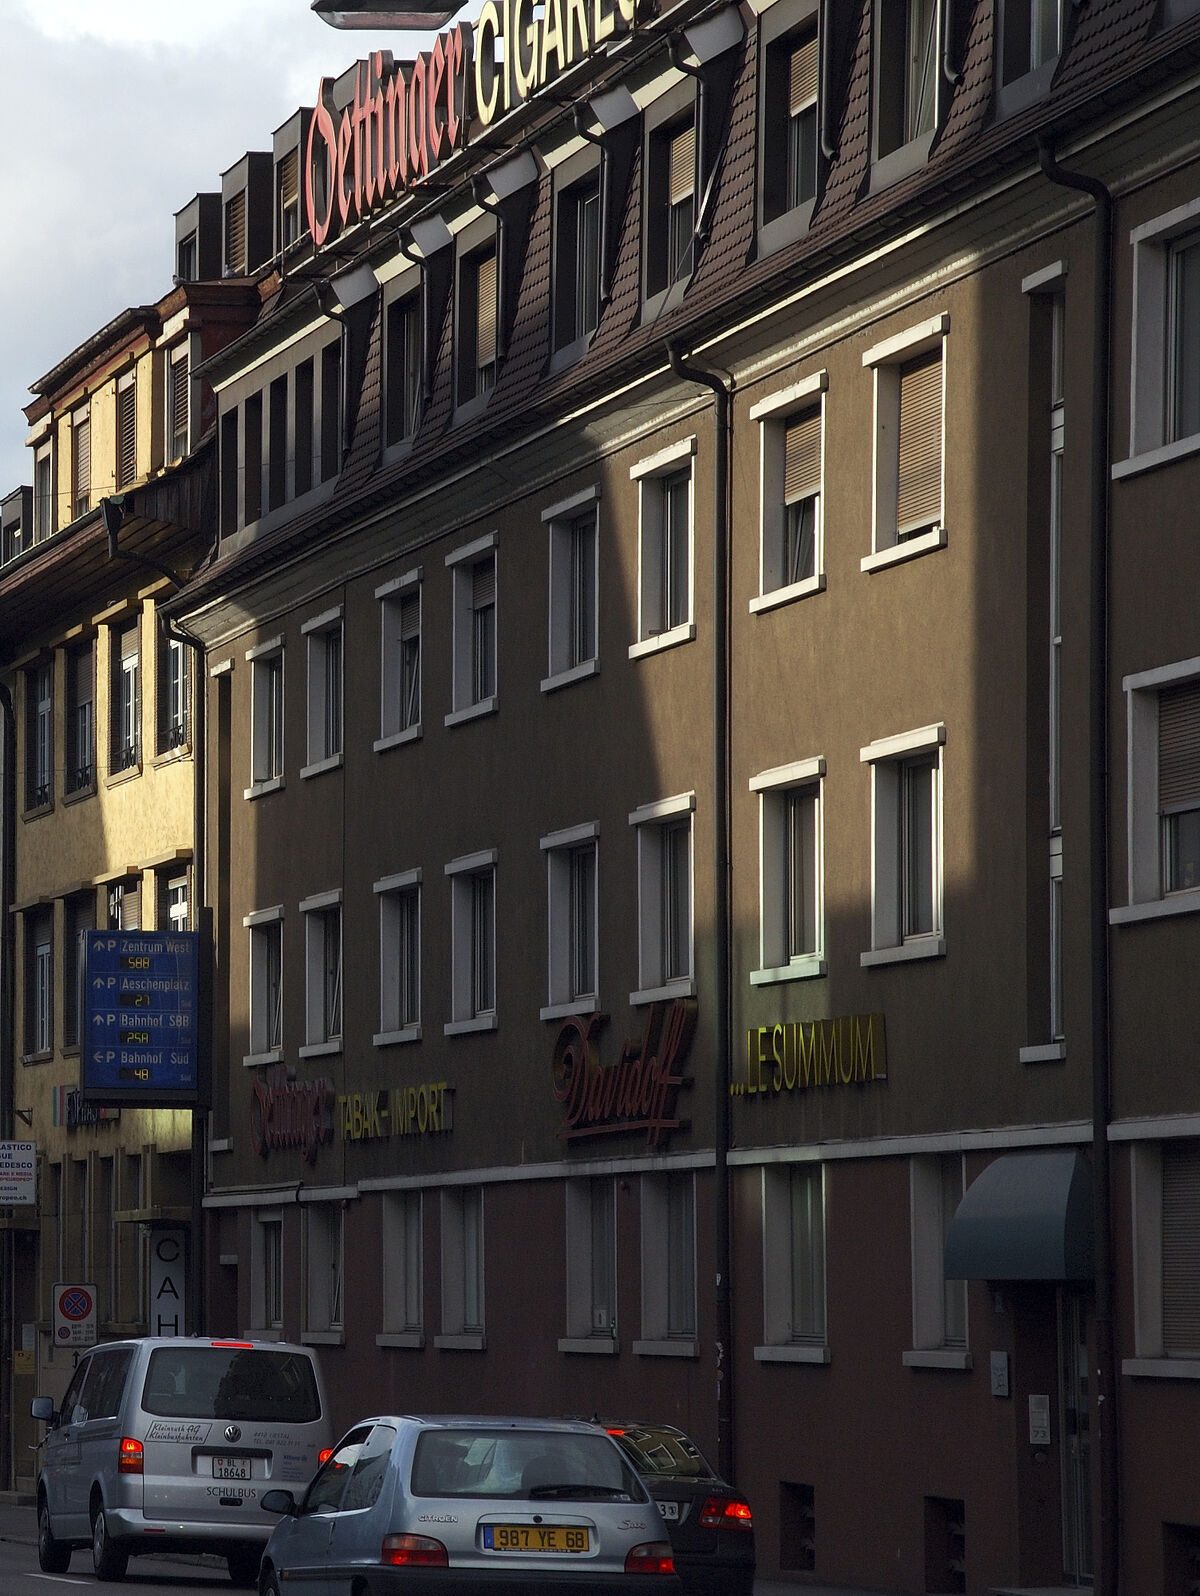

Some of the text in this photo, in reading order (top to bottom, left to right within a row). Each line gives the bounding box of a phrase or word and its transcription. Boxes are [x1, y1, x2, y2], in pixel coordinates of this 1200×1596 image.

[305, 21, 462, 246] Oettinger
[122, 940, 163, 953] Zentrum
[166, 940, 190, 953] West
[122, 977, 190, 993] Aeschenplatz
[121, 1014, 163, 1027] Bahnhof
[169, 1015, 190, 1027] SBB
[121, 1052, 163, 1064] Bahnhof
[170, 1052, 190, 1065] Süd
[772, 1015, 875, 1092] SUMMUM
[133, 1068, 149, 1081] 48
[553, 999, 688, 1145] Davidoff
[219, 1467, 247, 1479] 18648
[206, 1486, 257, 1499] SCHULBUS
[499, 1529, 585, 1548] 987 YE 68
